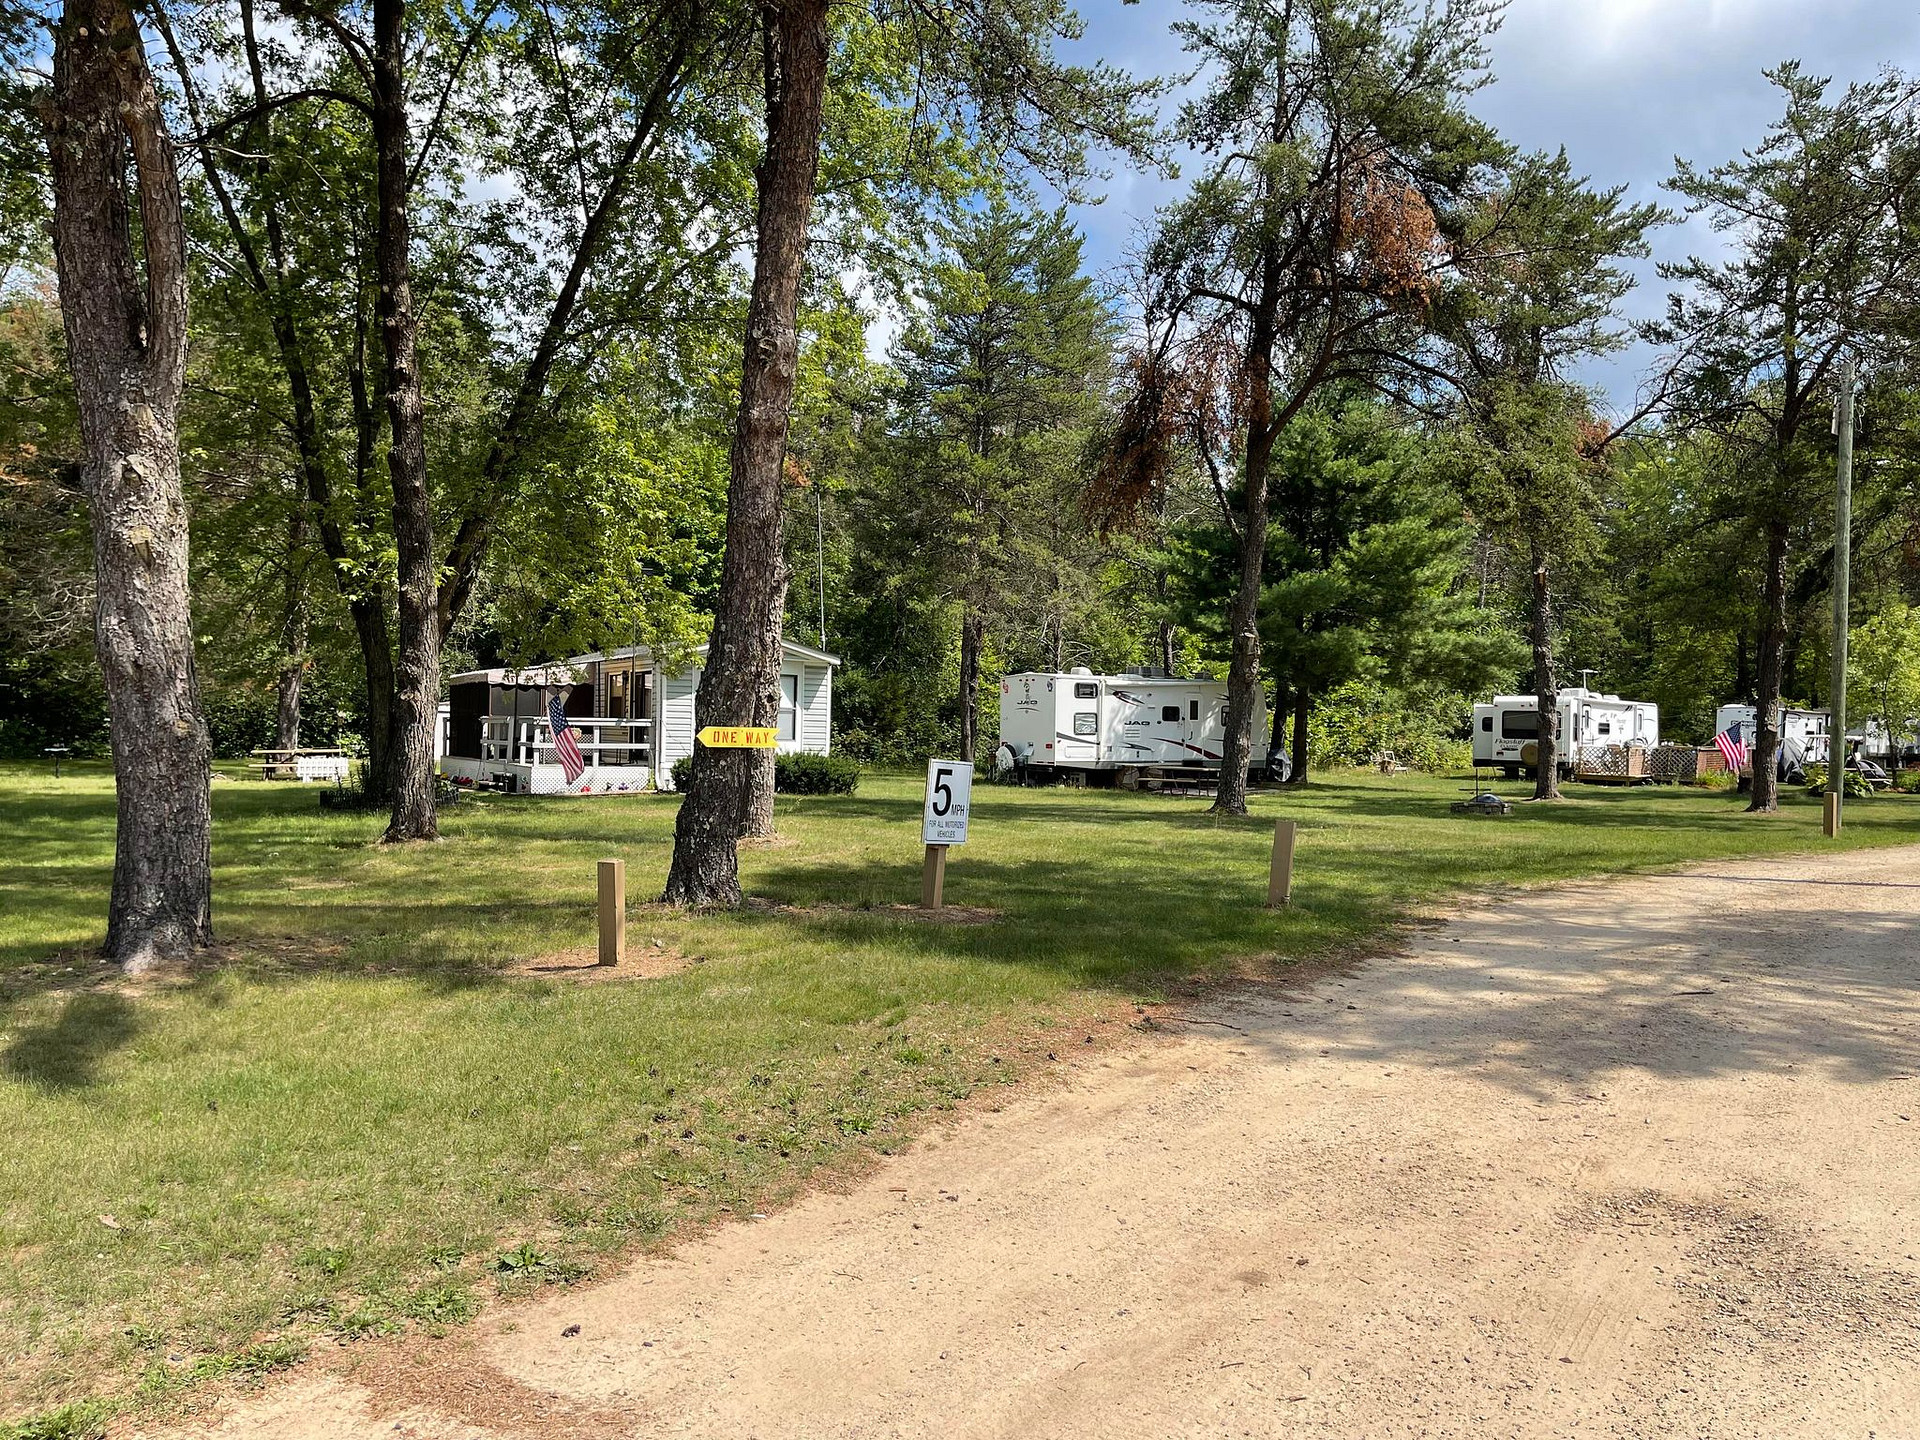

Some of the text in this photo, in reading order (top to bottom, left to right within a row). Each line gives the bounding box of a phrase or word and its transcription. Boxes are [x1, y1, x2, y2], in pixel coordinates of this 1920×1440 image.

[713, 731, 769, 744] ONE WAY
[932, 768, 965, 817] 5 MPH
[929, 820, 937, 828] FOR
[944, 820, 965, 829] MOTORIZED
[937, 830, 956, 839] VEHICLES
